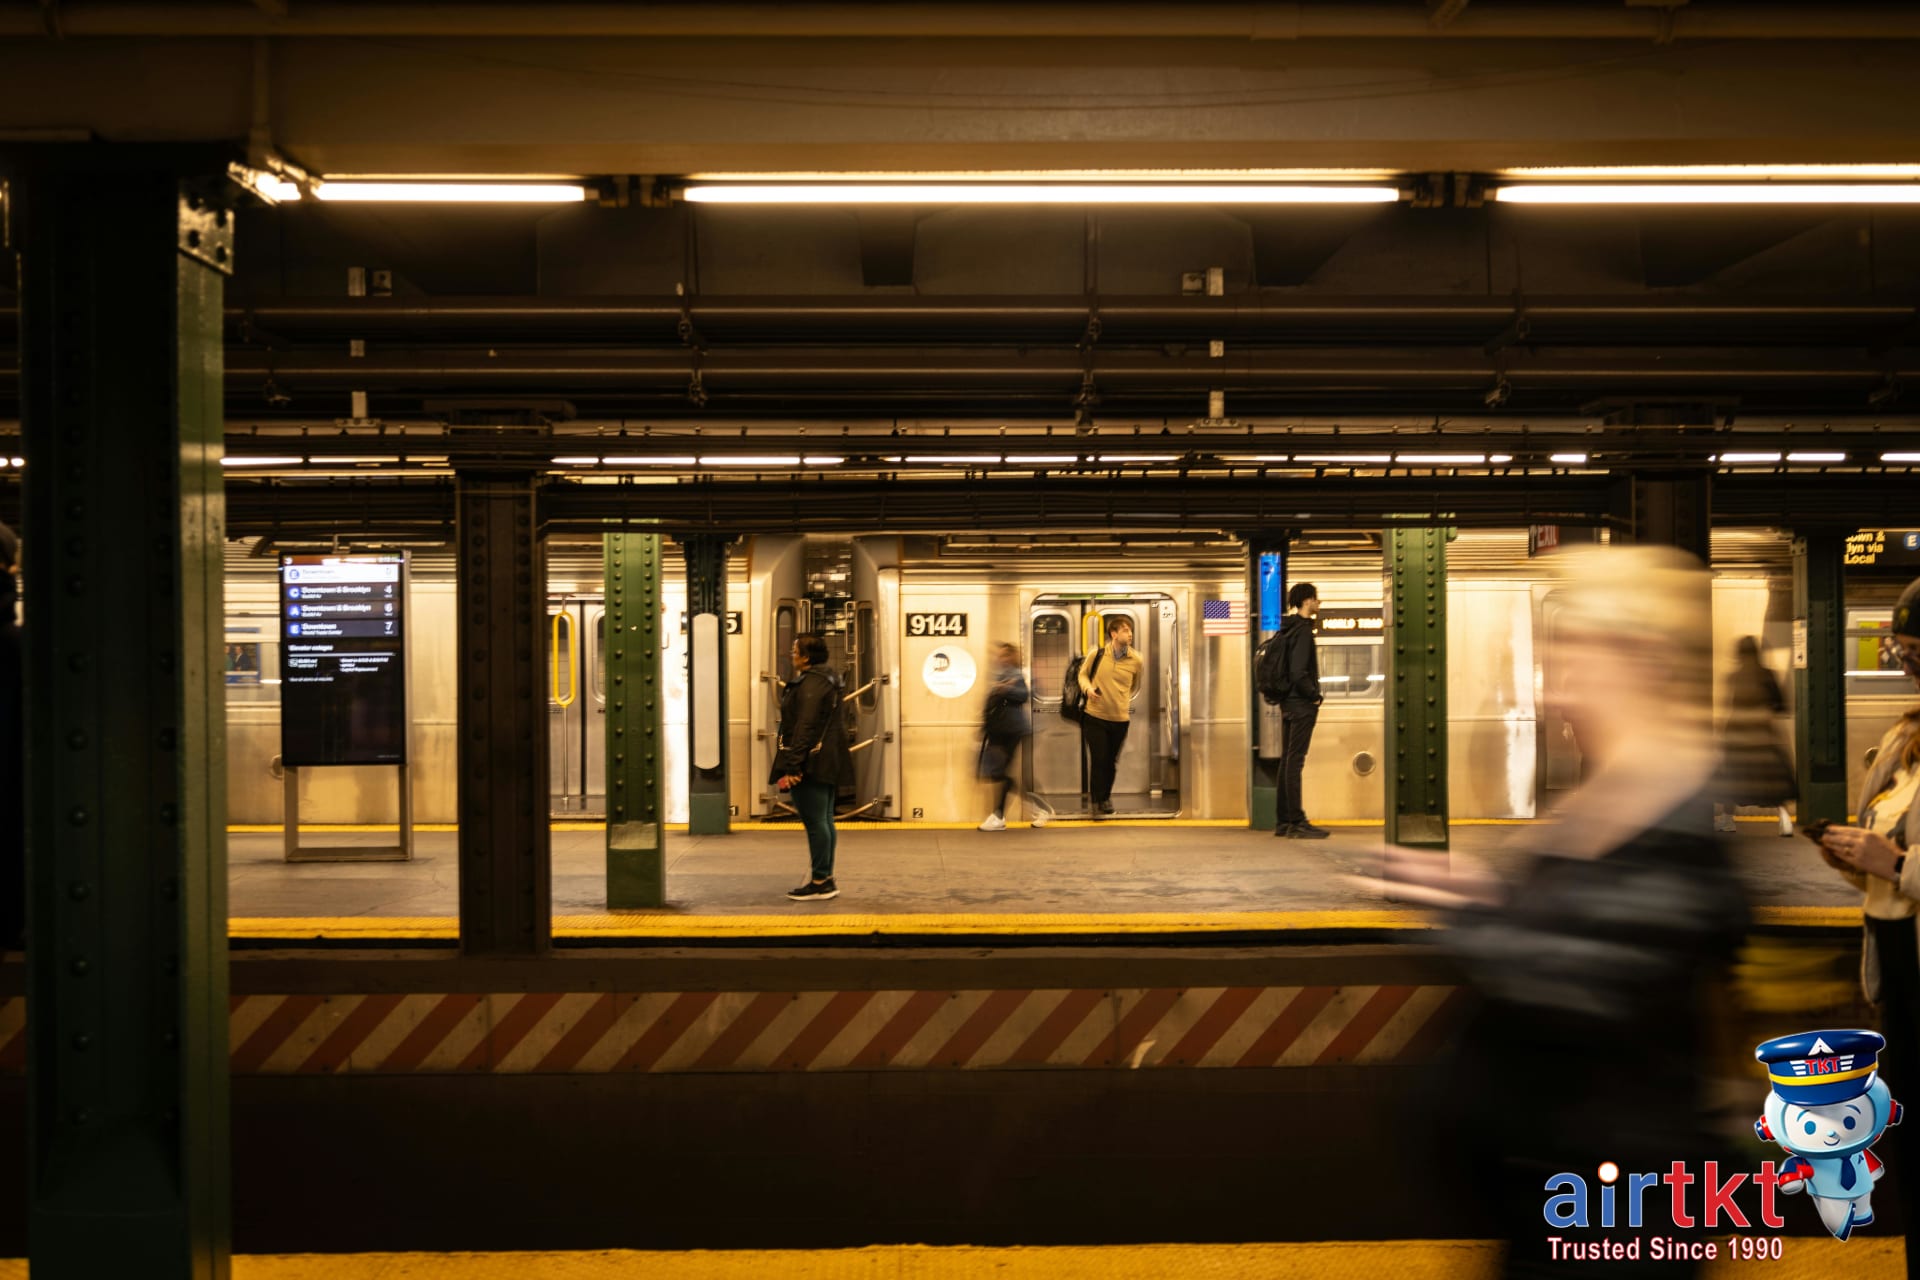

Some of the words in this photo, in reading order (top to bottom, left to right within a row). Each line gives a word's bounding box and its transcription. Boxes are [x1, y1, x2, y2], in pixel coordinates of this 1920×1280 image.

[1876, 530, 1886, 542] &
[1907, 535, 1918, 547] E
[1866, 542, 1884, 553] via
[1843, 553, 1876, 565] Local
[384, 621, 393, 630] 7
[911, 614, 963, 635] 9144
[914, 809, 922, 818] 2
